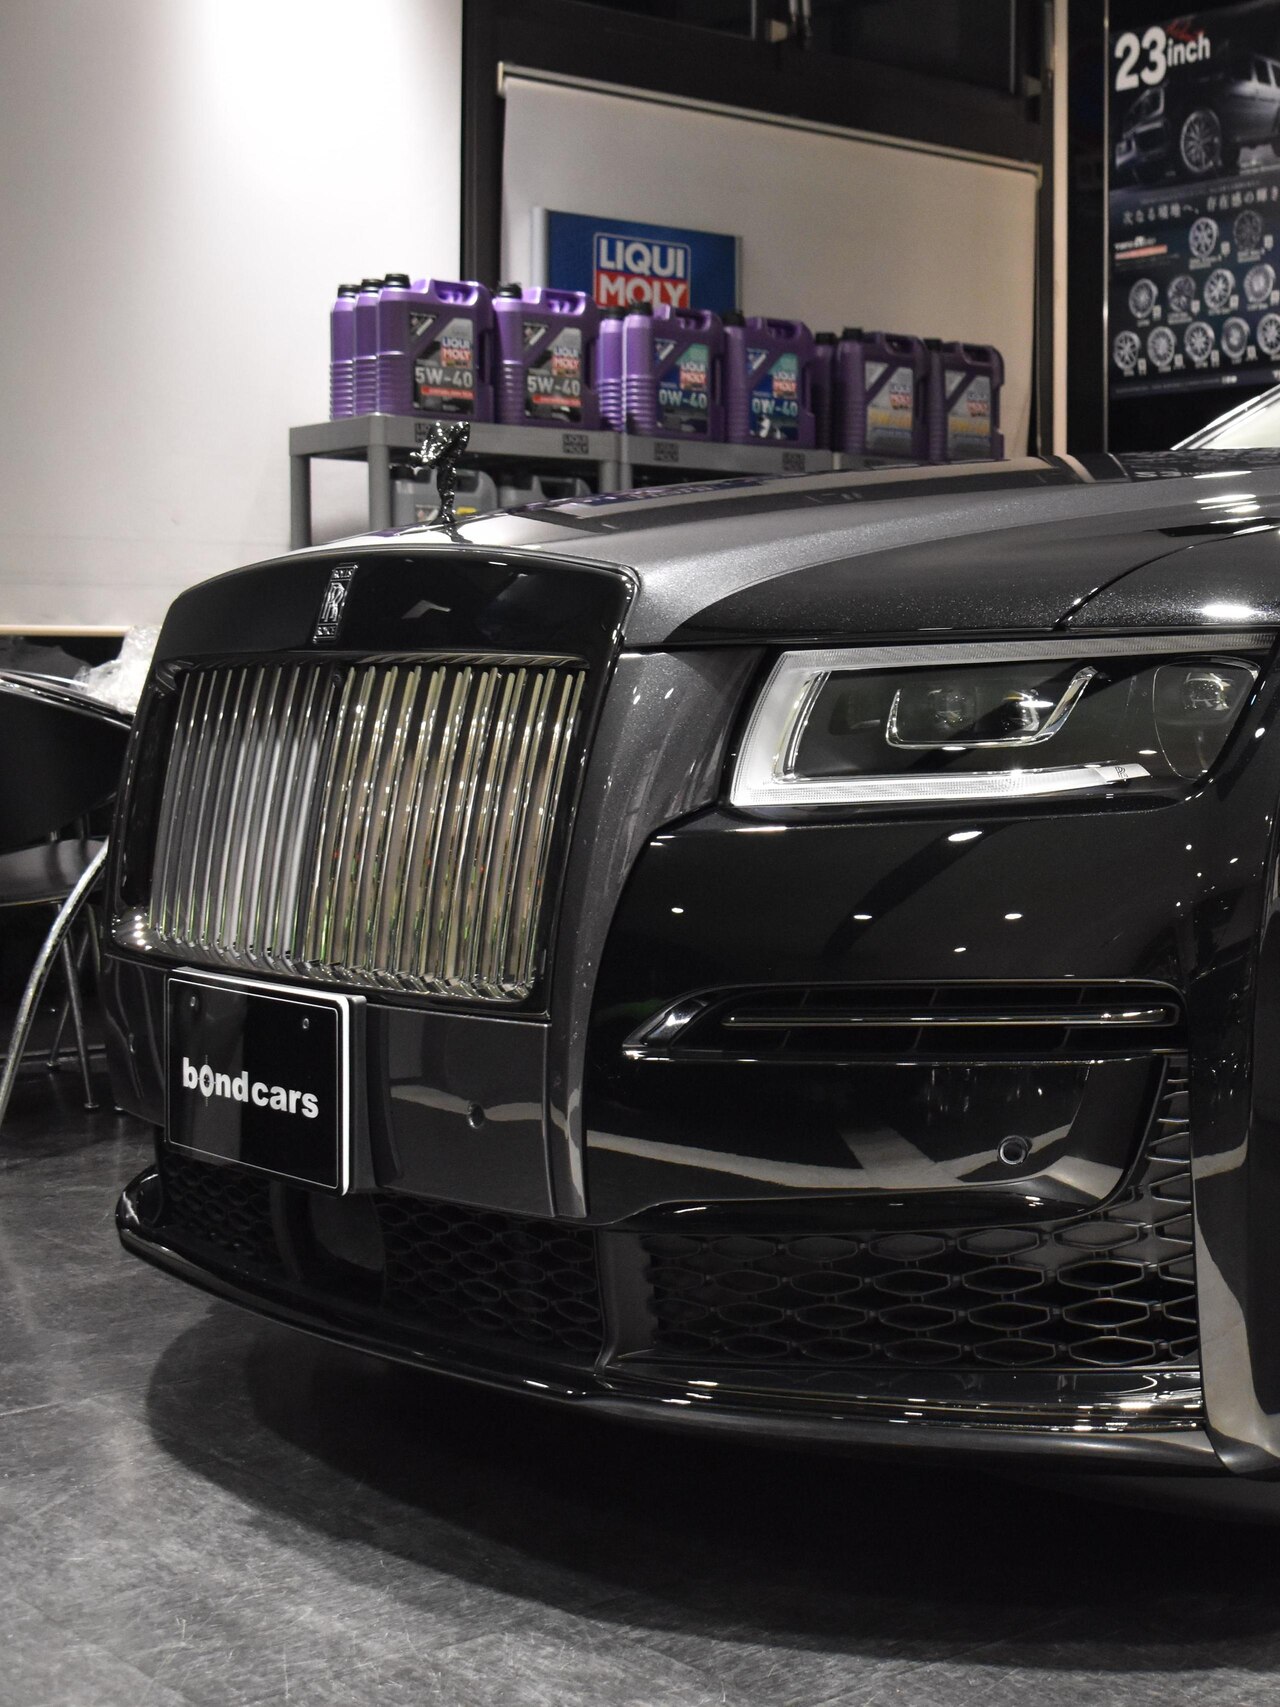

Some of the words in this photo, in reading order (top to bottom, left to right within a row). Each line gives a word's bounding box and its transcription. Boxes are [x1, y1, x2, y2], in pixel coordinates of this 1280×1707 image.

[600, 238, 685, 279] LIQUI
[599, 273, 687, 308] MOLY
[442, 336, 471, 349] LIQUI
[441, 348, 472, 362] MOLY
[414, 366, 474, 389] 5W-40
[526, 374, 582, 397] 5W-40
[658, 388, 708, 410] 0W-40
[751, 397, 799, 418] 0W-40
